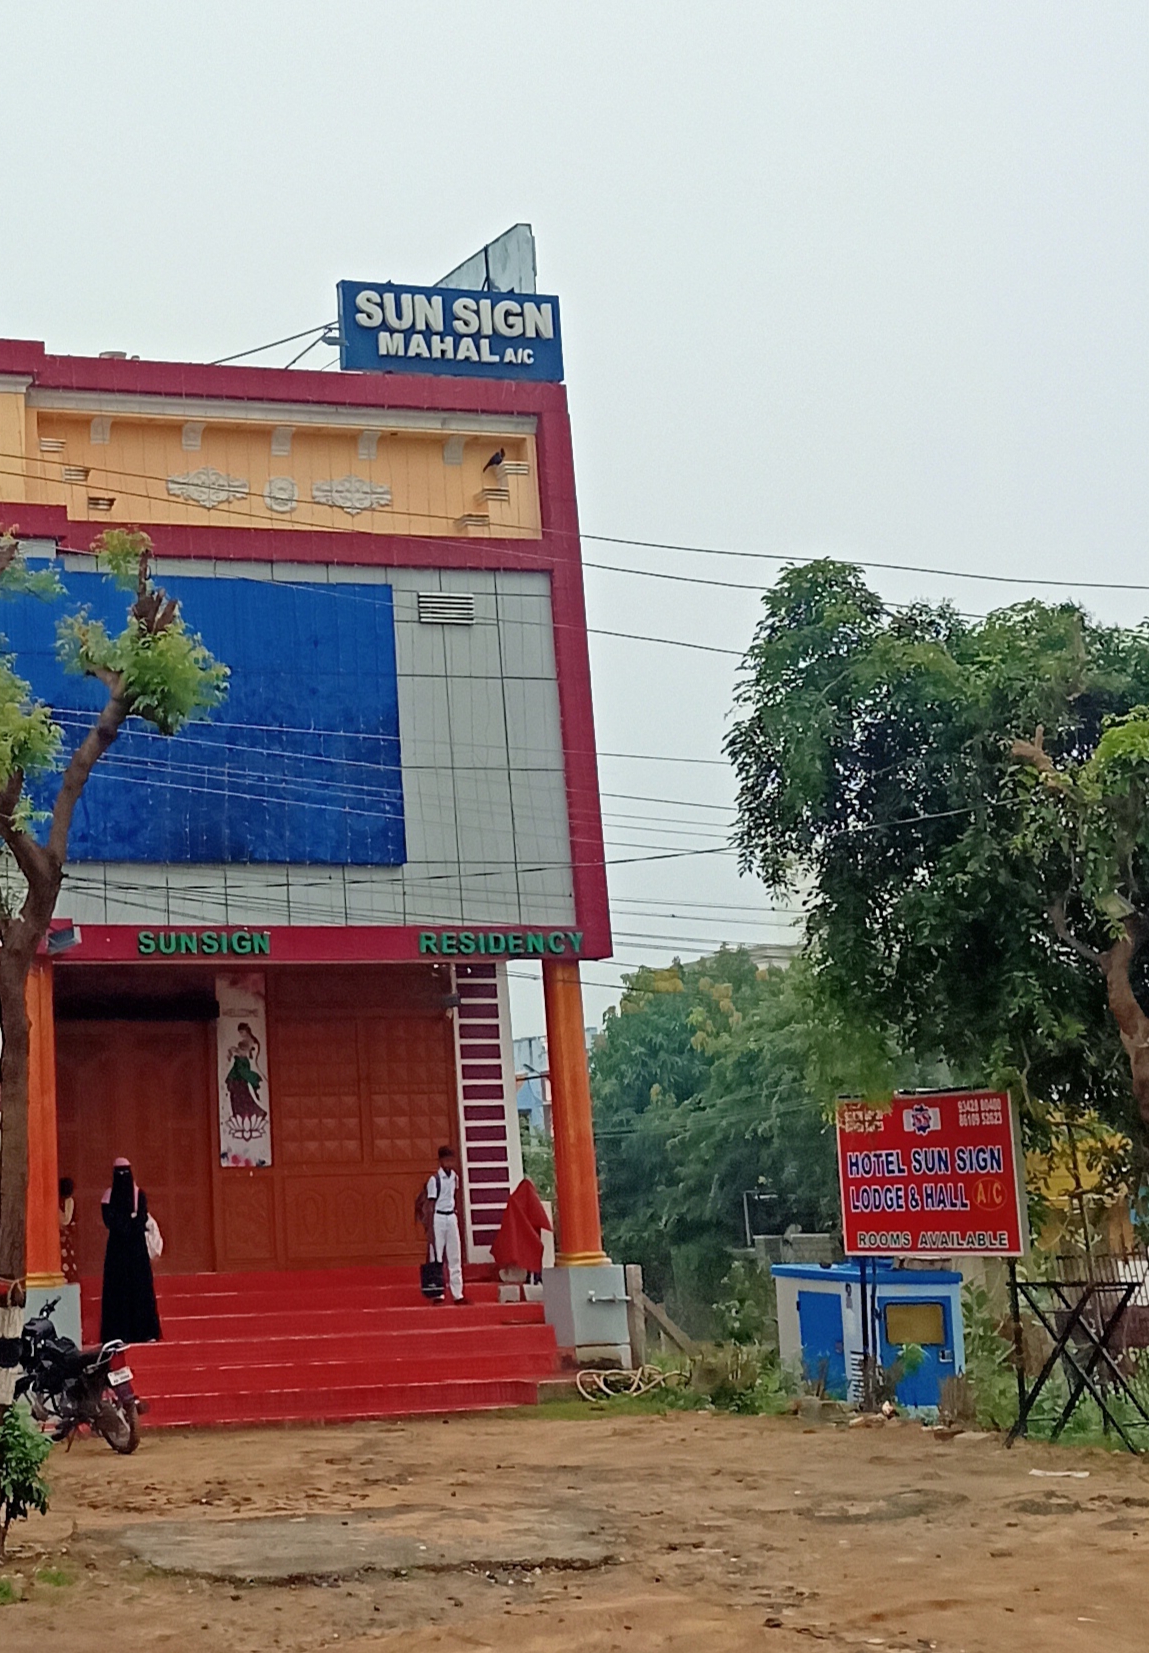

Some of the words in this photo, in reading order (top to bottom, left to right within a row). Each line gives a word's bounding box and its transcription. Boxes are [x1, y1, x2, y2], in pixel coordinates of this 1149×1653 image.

[355, 290, 443, 333] SUN
[453, 298, 554, 339] SIGN
[378, 331, 500, 363] MAHAL
[503, 347, 534, 364] A/C
[419, 932, 584, 955] RESIDENCY
[847, 1149, 907, 1178] HOTEL
[911, 1146, 951, 1175] SUN
[955, 1145, 1003, 1174] SIGN
[850, 1184, 905, 1213] LODGE
[908, 1184, 921, 1212] &
[923, 1182, 970, 1211] HALL
[977, 1180, 1002, 1204] A/C
[857, 1231, 911, 1248] ROOMS
[917, 1231, 1009, 1249] AVAILABLE
